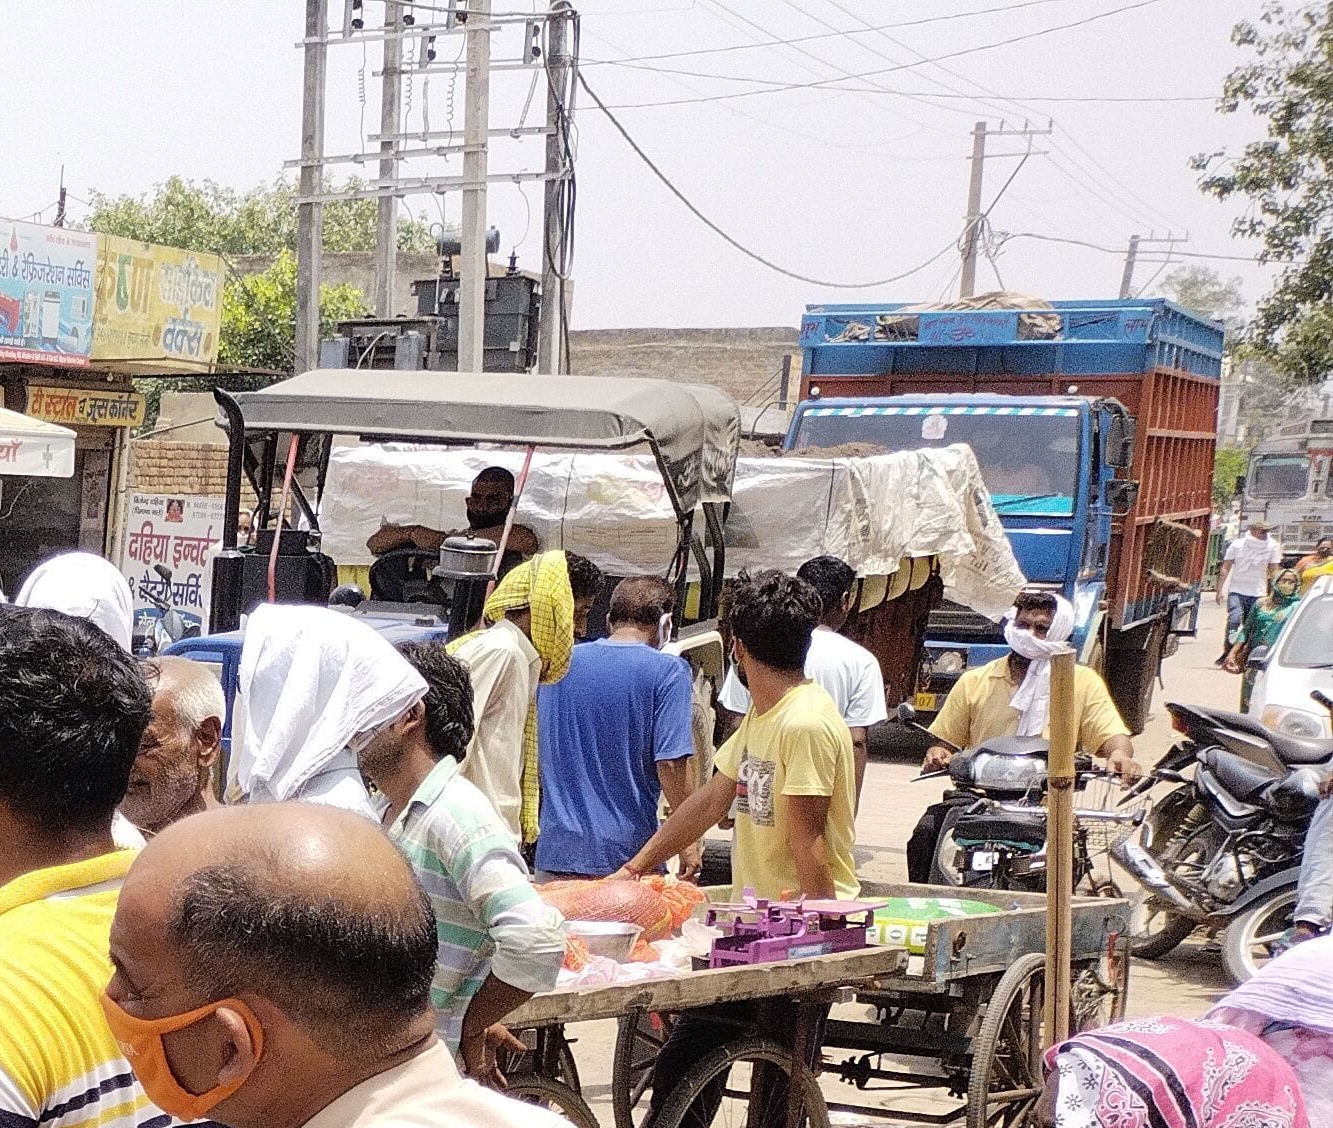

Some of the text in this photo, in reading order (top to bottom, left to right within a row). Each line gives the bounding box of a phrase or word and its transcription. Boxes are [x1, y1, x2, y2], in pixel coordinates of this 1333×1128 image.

[66, 260, 92, 289] सर्विस
[128, 520, 221, 570] दहिया इन्वर्ट
